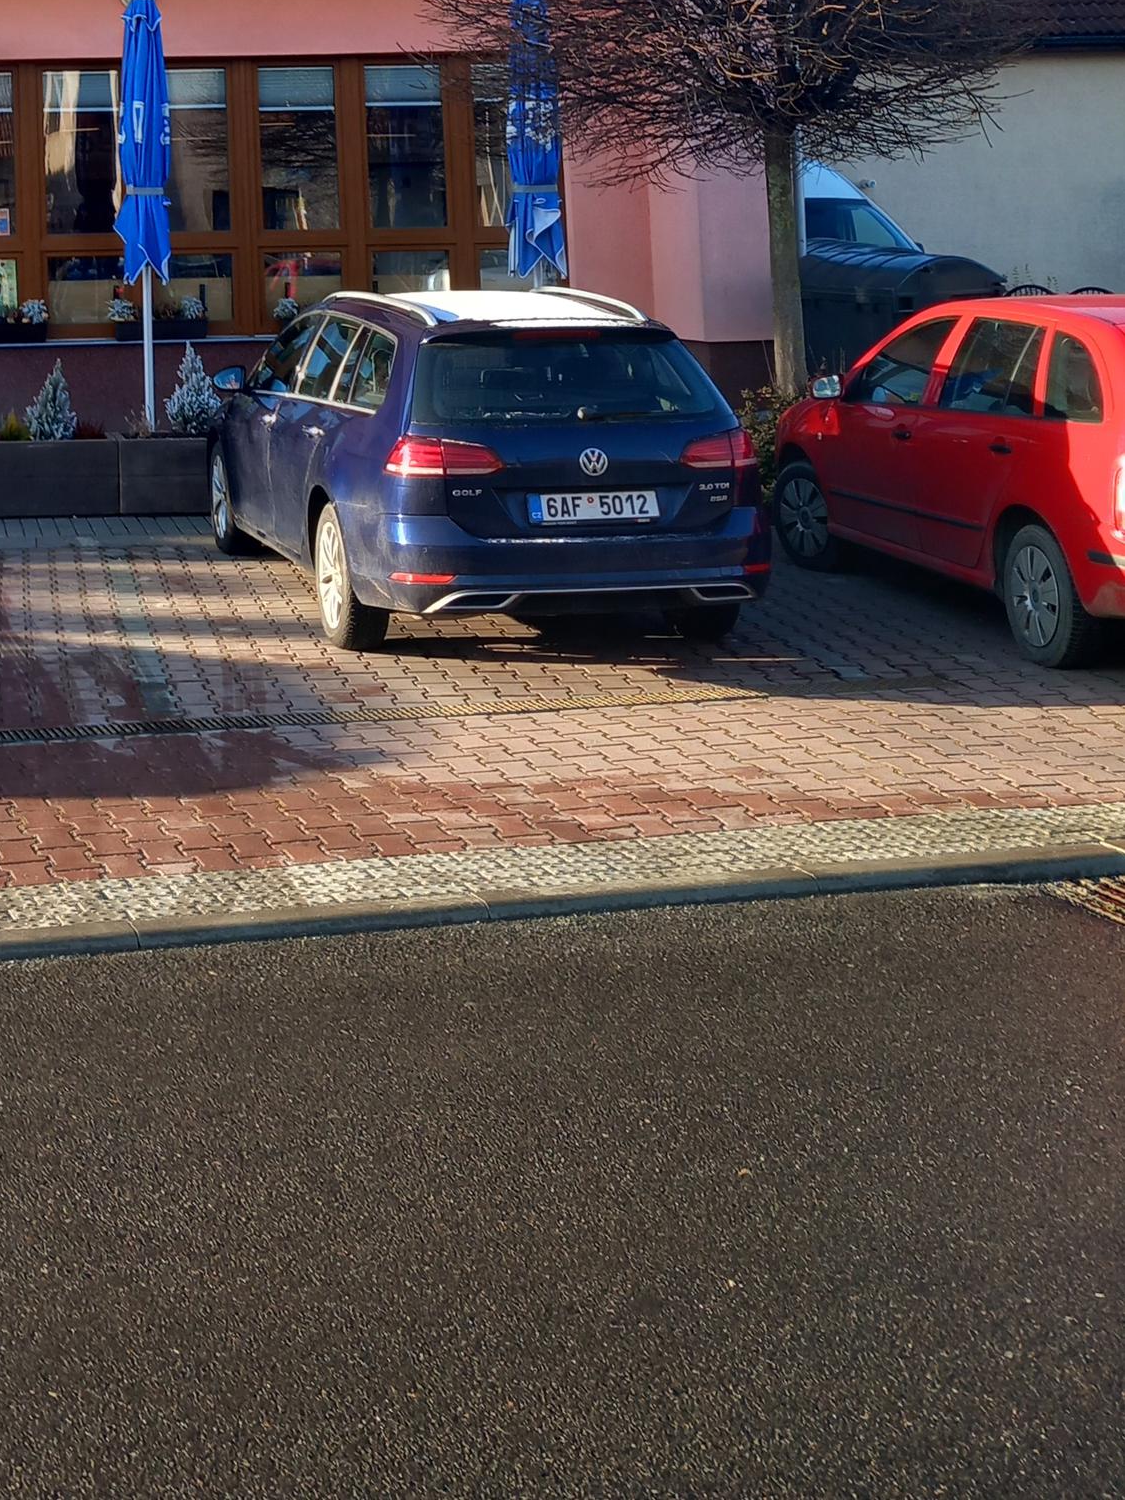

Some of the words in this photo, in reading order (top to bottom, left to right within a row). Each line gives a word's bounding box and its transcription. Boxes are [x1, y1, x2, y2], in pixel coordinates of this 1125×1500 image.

[452, 489, 483, 497] GOLF
[546, 496, 582, 518] 6AF
[598, 493, 649, 515] 5012
